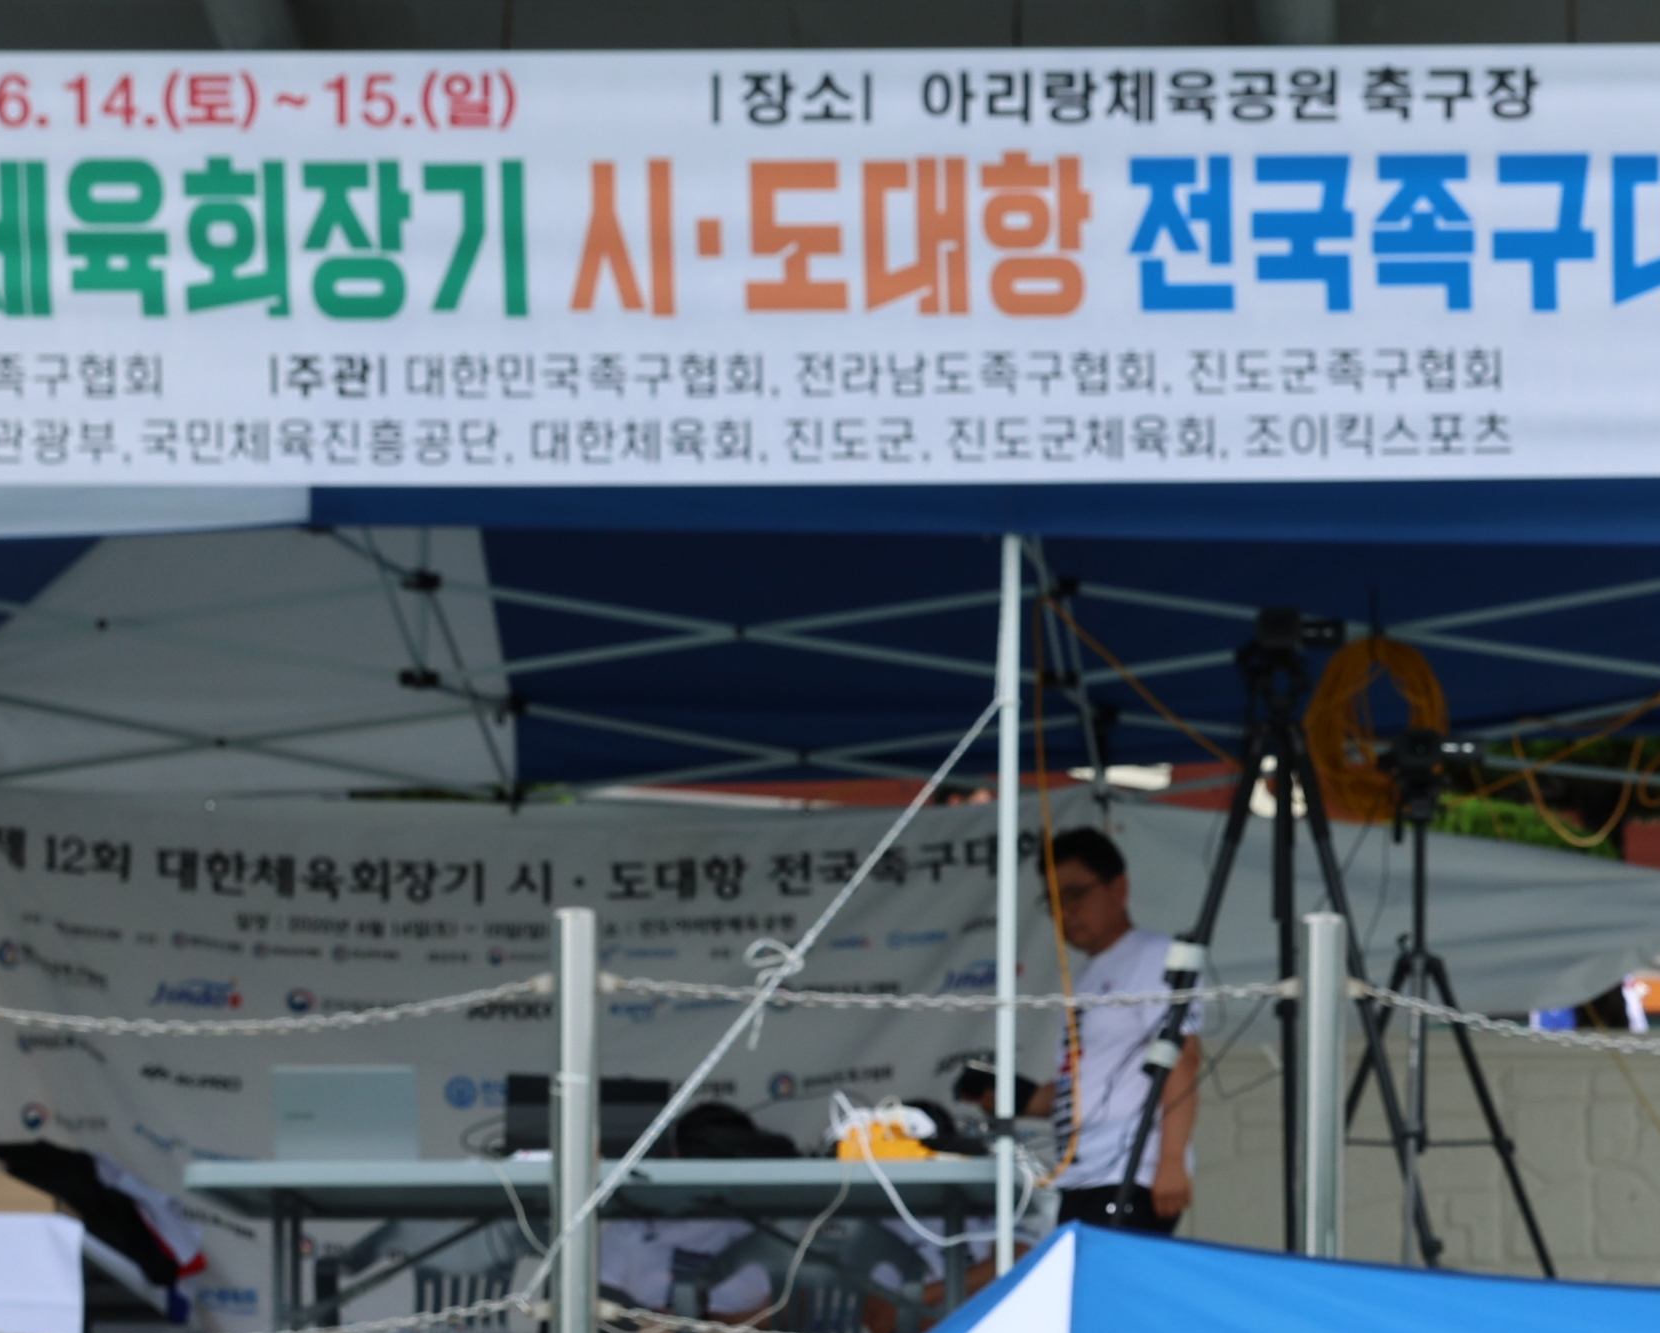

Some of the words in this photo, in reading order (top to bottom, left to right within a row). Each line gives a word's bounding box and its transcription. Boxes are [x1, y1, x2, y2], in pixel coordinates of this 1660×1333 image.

[920, 67, 1339, 126] 아리랑체육공원
[1362, 65, 1541, 121] 축구장
[569, 150, 1093, 318] 시·도대항
[1189, 347, 1504, 393] 진도군족구협회
[1246, 411, 1510, 458] 조이킥스포츠
[43, 834, 132, 881] 12회
[156, 845, 486, 902] 대한체육회장기
